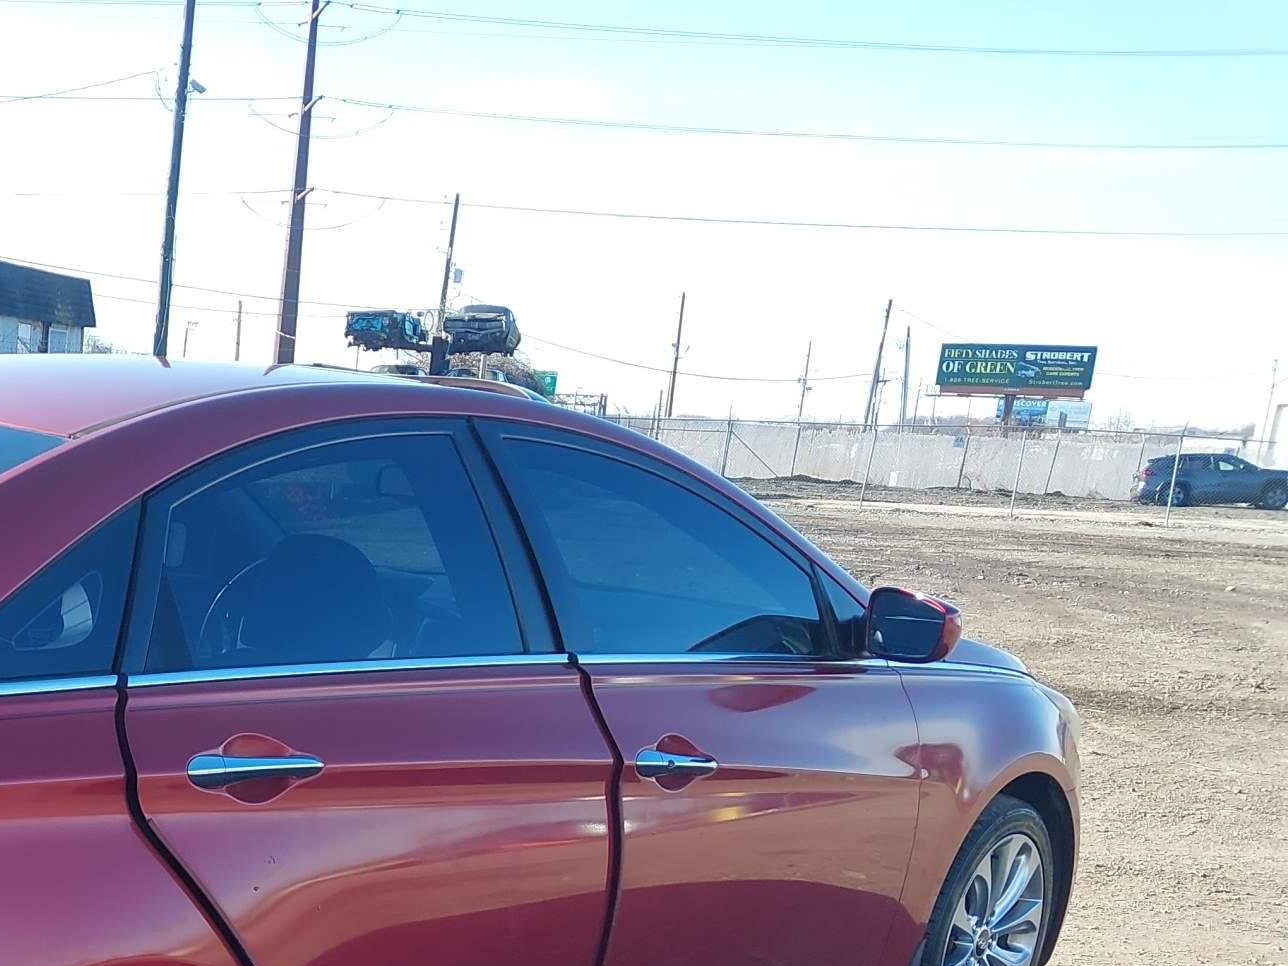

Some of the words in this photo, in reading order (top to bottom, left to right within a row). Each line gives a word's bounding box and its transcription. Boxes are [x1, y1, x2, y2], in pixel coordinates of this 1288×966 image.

[944, 348, 972, 358] FIFTY
[975, 349, 1018, 359] SHADES
[1025, 351, 1091, 362] STROBERT
[942, 360, 963, 373] OF
[965, 361, 1016, 374] GREEN
